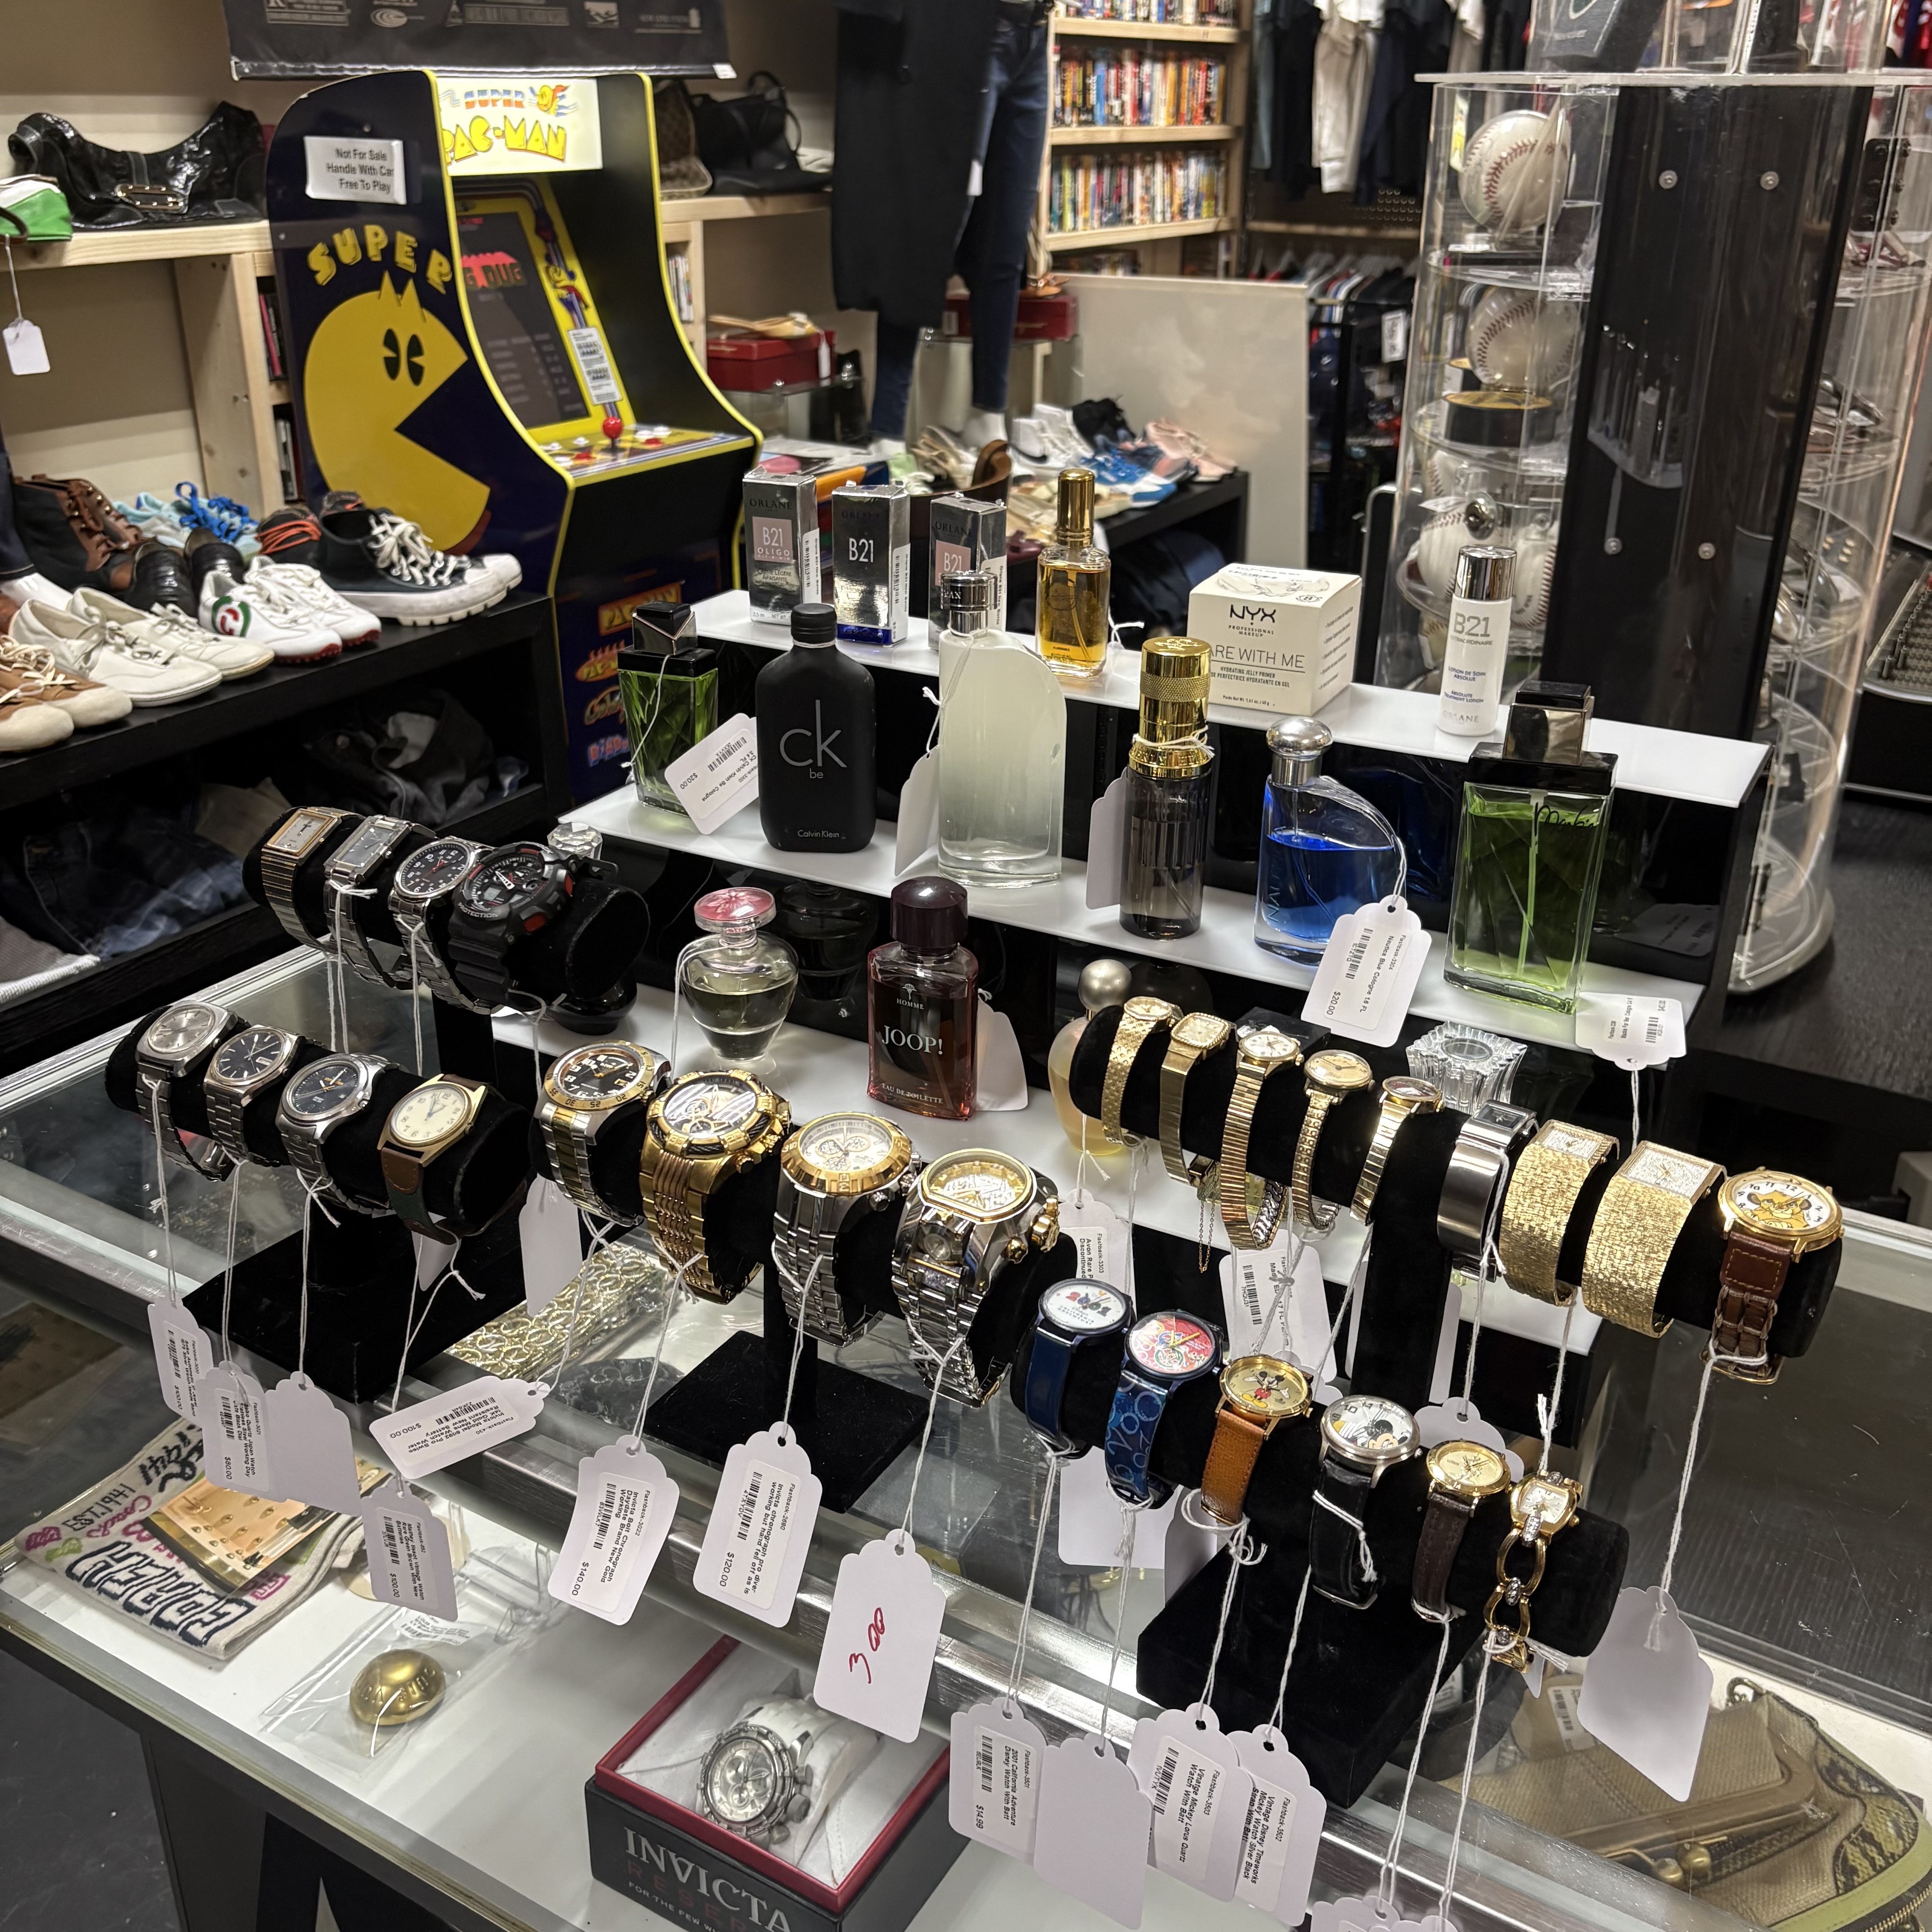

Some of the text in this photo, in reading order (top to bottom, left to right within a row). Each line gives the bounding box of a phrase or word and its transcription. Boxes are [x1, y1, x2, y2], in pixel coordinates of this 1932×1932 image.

[464, 89, 526, 110] SUPER
[336, 149, 387, 161] Not For Sale
[442, 115, 566, 166] PAC-MAN
[327, 163, 378, 175] Handle With
[339, 179, 391, 194] Free Play
[307, 224, 452, 295] SUPER
[758, 547, 790, 557] OLIGO
[763, 527, 783, 547] B21
[849, 538, 874, 563] B21
[944, 552, 962, 572] B21
[1228, 625, 1274, 635] PROFESSIONAL
[1230, 604, 1276, 623] NYX
[1453, 612, 1490, 637] B21
[1450, 635, 1493, 645] EXTRAORDINAIRE
[1220, 666, 1245, 675] HYDRATING
[1239, 648, 1276, 665] WITH
[1282, 653, 1305, 668] ME
[1217, 673, 1274, 686] PERFECTRICE HYDRATANTE
[779, 699, 847, 768] ck
[680, 772, 698, 790] $20.00
[701, 760, 750, 802] Calvin Klein Cologne
[810, 768, 824, 779] be
[797, 830, 820, 838] Calvin
[458, 902, 498, 918] PROTECTION
[1360, 935, 1394, 1013] Nautica Blue Cologne FL
[897, 998, 925, 1010] HOMME
[1325, 990, 1341, 1015] $20.00
[882, 1025, 943, 1055] JOOP!
[882, 1083, 944, 1104] EAU DE TOILETTE
[1079, 1238, 1088, 1279] Discontinued
[1096, 1233, 1104, 1273] Flashback-3303
[390, 1422, 421, 1439] $100.00
[407, 1413, 488, 1450] Gold Mens Watch Water
[408, 1411, 504, 1454] Invicta Model Pro Swiss
[425, 1404, 499, 1437] Resistant New Battery
[62, 1482, 136, 1532] EST.1941
[614, 1488, 626, 1518] Working
[635, 1490, 650, 1536] Flashback-3022
[779, 1483, 796, 1531] Flashback-2680
[396, 1521, 405, 1543] Batteries
[600, 1489, 632, 1583] Daydate Brand New Gold
[606, 1491, 639, 1582] Invicta Bolt Chronograph
[745, 1481, 777, 1585] working but hand fell off as
[750, 1483, 783, 1593] Invicta chronograph pro diver
[405, 1523, 425, 1600] Mathey Vintage Watch
[571, 1560, 589, 1596] $140.00
[718, 1551, 734, 1588] $120.00
[389, 1573, 400, 1597] $100.00
[1177, 1763, 1198, 1823] Watch With Batt
[1203, 1769, 1220, 1815] Flashback-3503
[1178, 1768, 1205, 1863] Vinatge Mickey Lorus Quartz
[1241, 1786, 1259, 1842] Strap With Batt
[1275, 1797, 1290, 1842] Flashback-3502
[1242, 1789, 1267, 1880] Mickey Watch Silver Black
[1249, 1795, 1275, 1884] Vintage Disney Timeworks
[624, 1827, 791, 1932] INVICTA
[629, 1881, 700, 1925] FOR THE FEW
